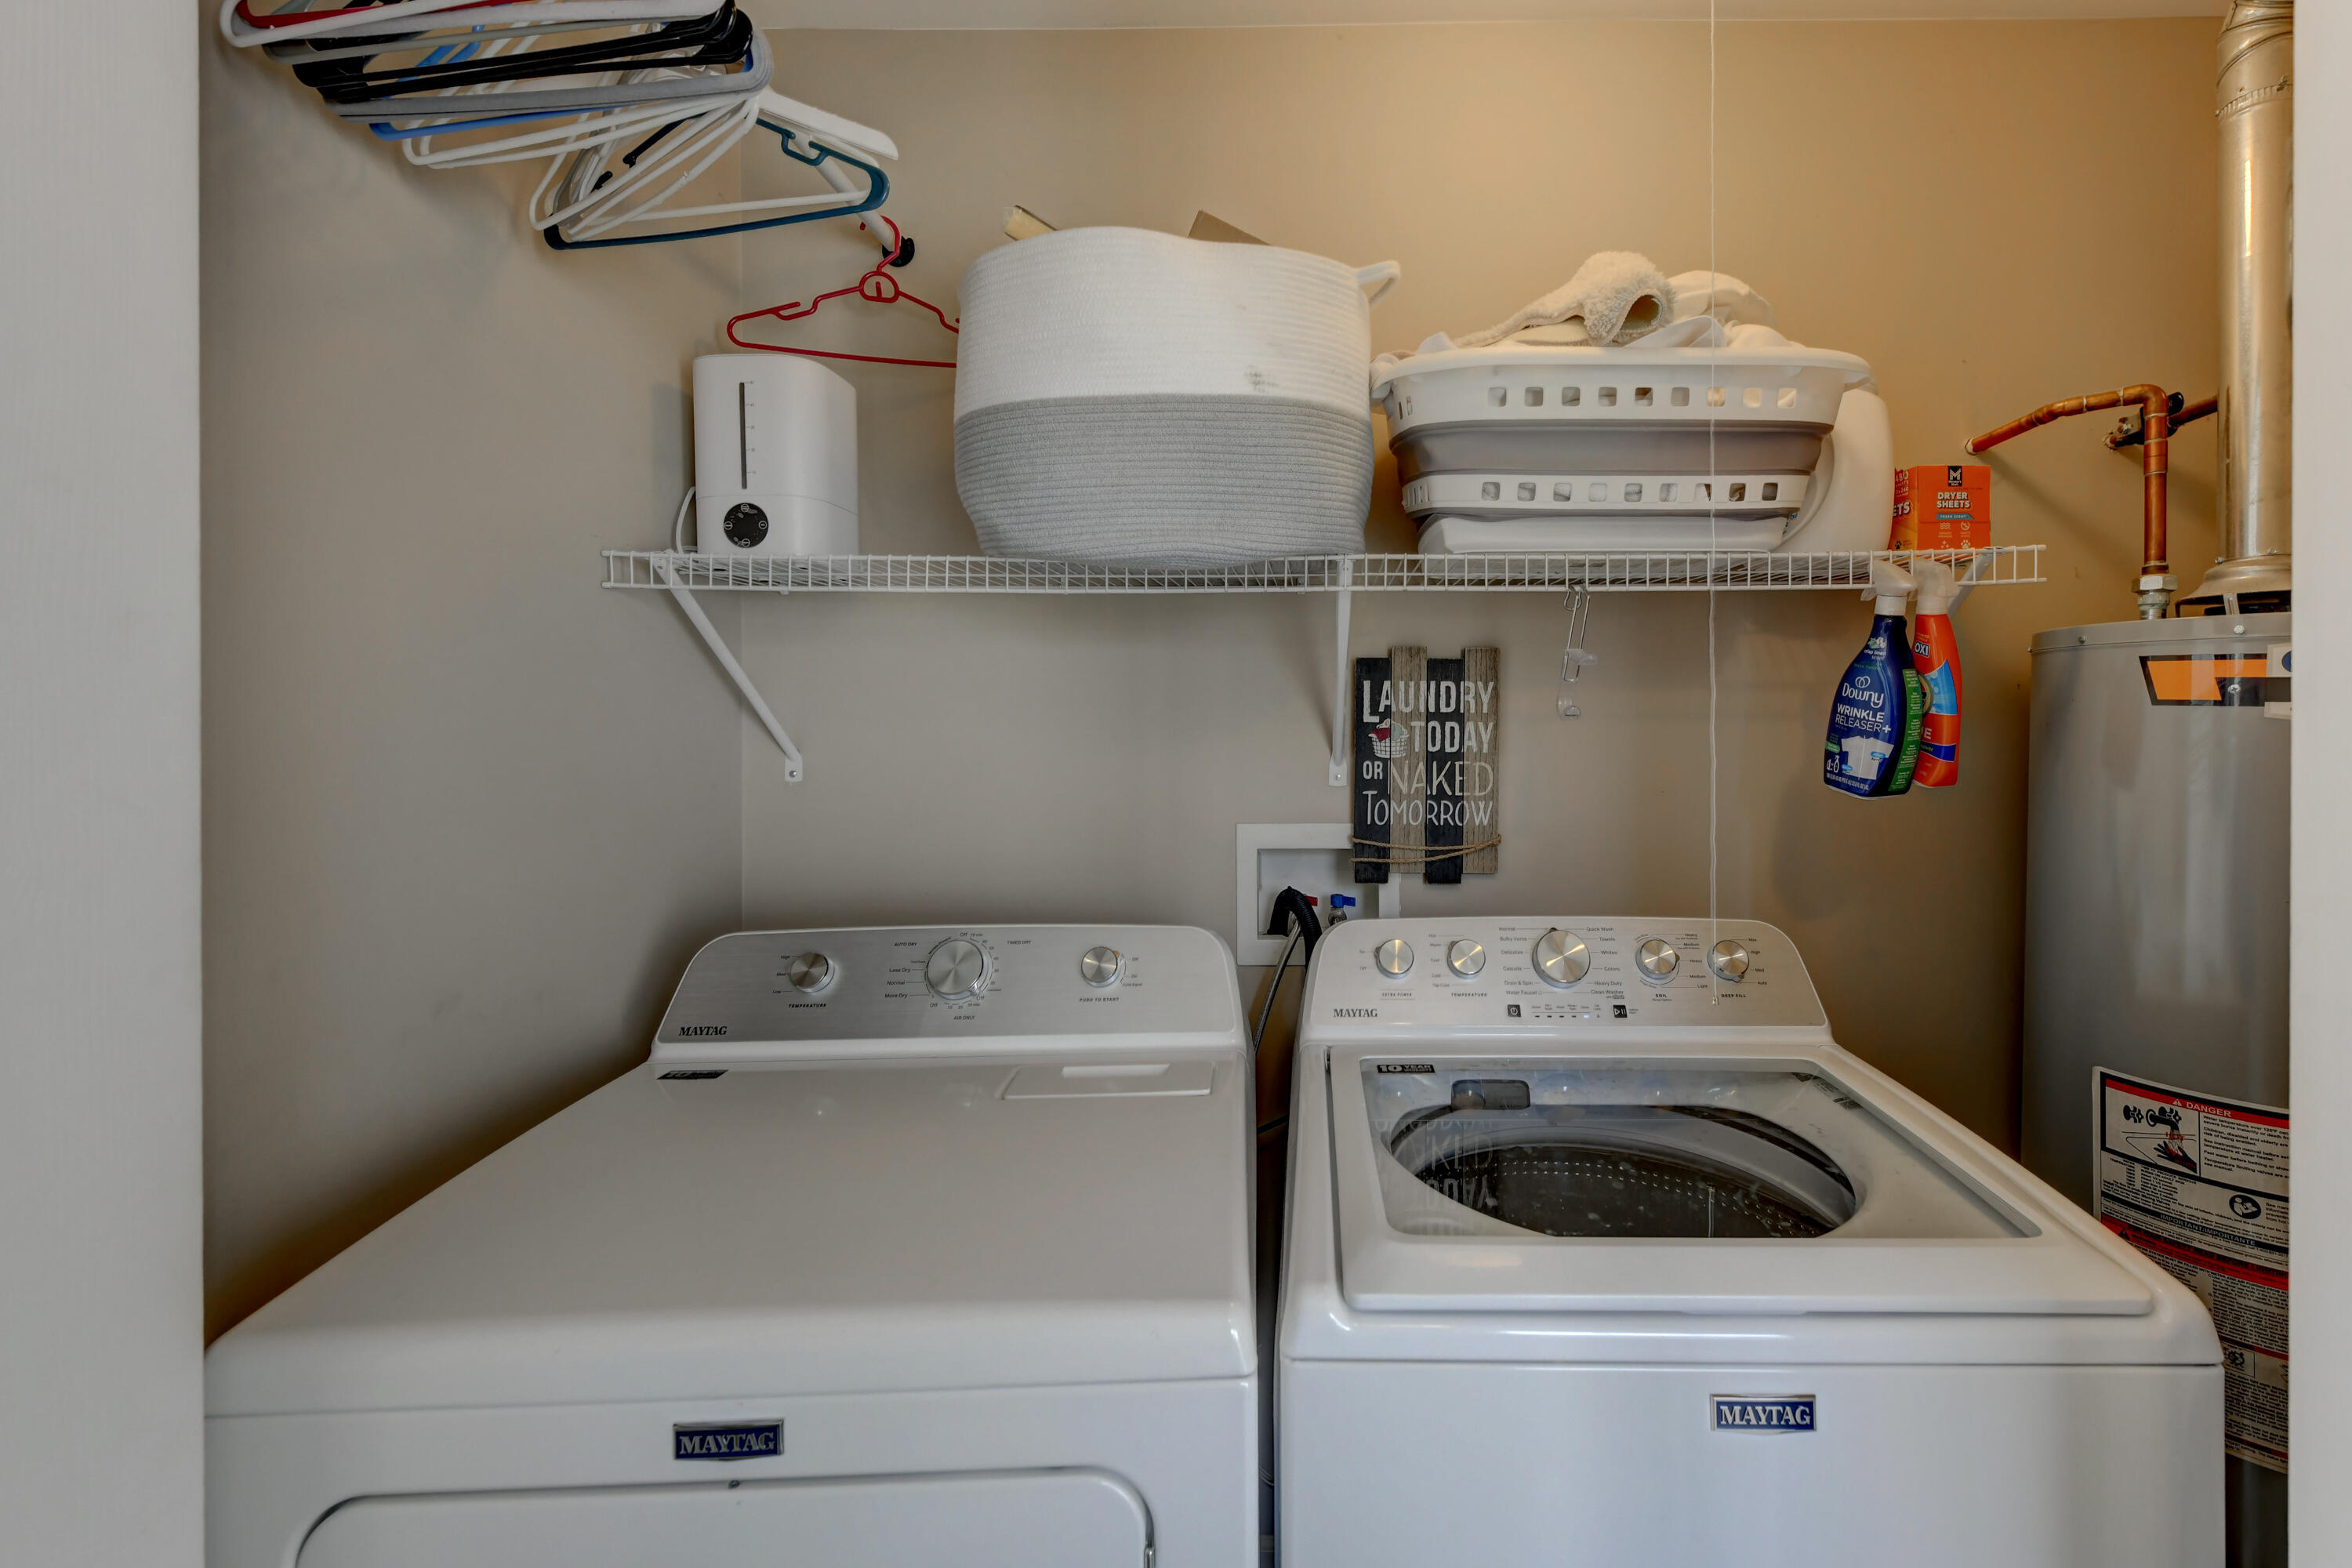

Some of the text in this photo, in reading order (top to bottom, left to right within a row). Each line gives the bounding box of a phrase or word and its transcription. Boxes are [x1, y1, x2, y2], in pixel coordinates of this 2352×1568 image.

[1915, 641, 1929, 655] OXI
[1363, 680, 1494, 723] LAUNDRY
[1842, 683, 1884, 708] Downy
[1837, 703, 1885, 722] WRINKLE
[1411, 721, 1494, 753] TODAY
[1363, 760, 1494, 797] OR NAKED
[1363, 790, 1494, 826] TOMORROW
[1334, 1009, 1377, 1018] MAYTAG
[678, 1026, 728, 1036] MAYTAG
[2186, 1102, 2232, 1117] DANGER
[2219, 1118, 2249, 1128] temperature
[2204, 1143, 2233, 1152] temperature
[2204, 1156, 2234, 1167] Temperature
[2161, 1214, 2256, 1246] IMPORTANT/IMPORTANTE
[1720, 1406, 1810, 1425] MAYTAG
[679, 1432, 775, 1454] MAYTAG
